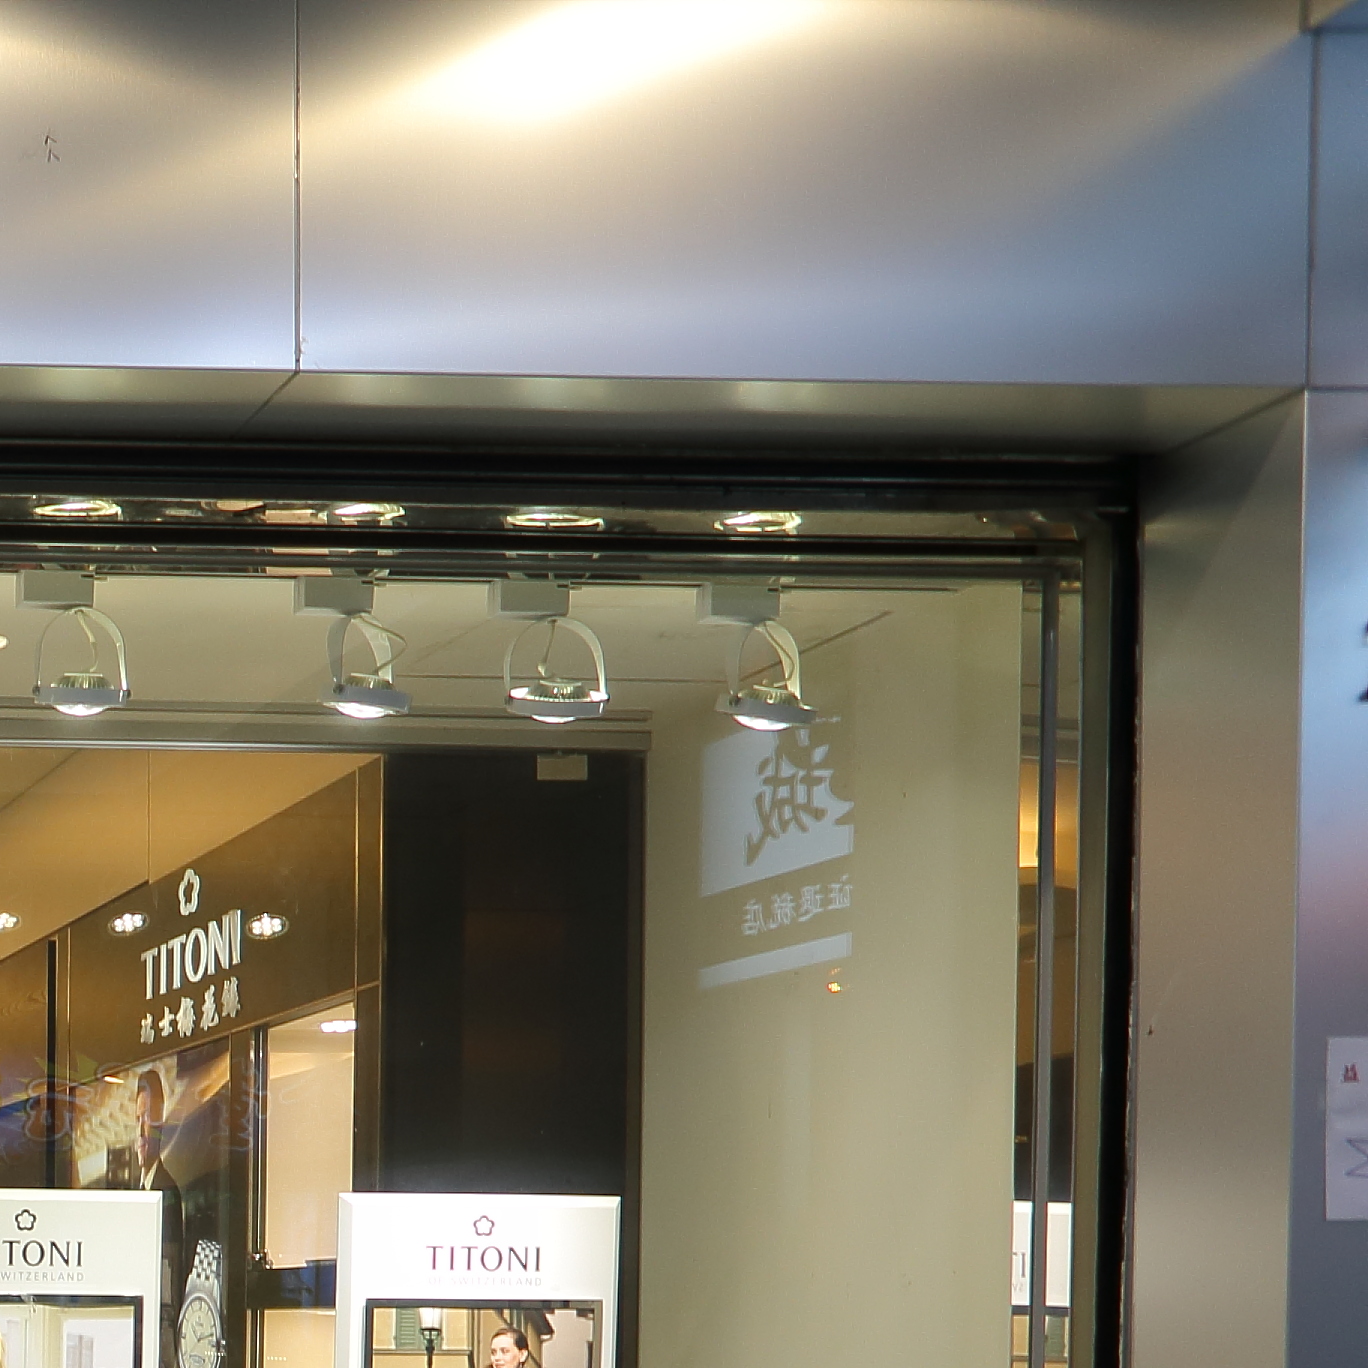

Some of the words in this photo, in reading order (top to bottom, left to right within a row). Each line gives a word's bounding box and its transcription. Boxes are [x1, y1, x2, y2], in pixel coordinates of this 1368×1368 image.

[140, 909, 242, 1000] TITONI
[425, 1245, 541, 1272] TITONI
[452, 1277, 542, 1287] SWITZERLAND
